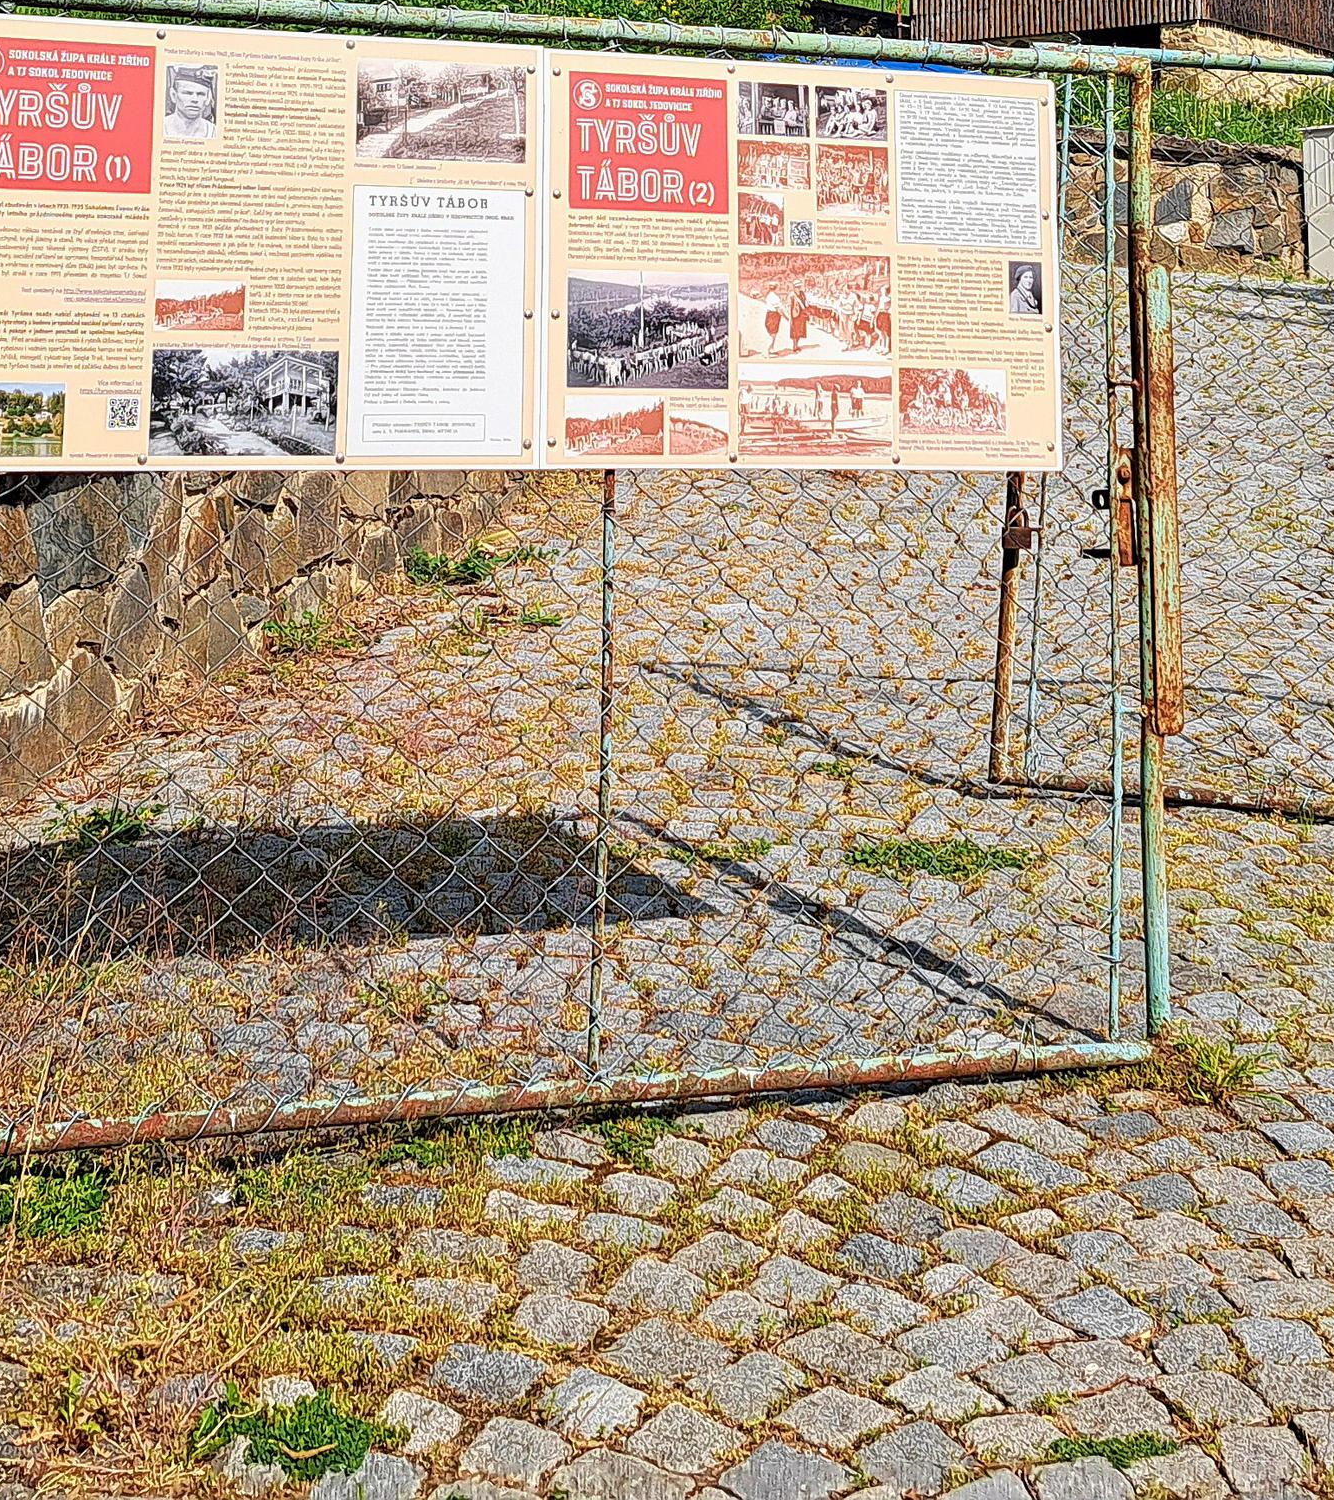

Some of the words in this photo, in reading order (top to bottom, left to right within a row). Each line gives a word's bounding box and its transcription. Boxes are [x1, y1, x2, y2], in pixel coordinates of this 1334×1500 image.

[8, 49, 59, 62] SOKOLSKÁ
[61, 51, 85, 64] ŽUPA
[87, 53, 116, 65] KRÁLE
[118, 54, 150, 67] JIŘÍHO
[8, 68, 14, 76] A
[16, 68, 27, 76] TJ
[28, 68, 59, 78] SOKOL
[60, 70, 113, 81] JEDOVNICE
[605, 83, 647, 95] SOKOLSKÁ
[648, 84, 669, 96] ŽUPA
[670, 86, 694, 97] KRÁLE
[605, 100, 611, 108] A
[612, 100, 621, 108] TJ
[622, 100, 648, 110] SOKOL
[649, 101, 692, 112] JEDOVNICE
[576, 113, 701, 158] TYRŠŮV
[105, 155, 131, 183] (1)
[576, 159, 684, 203] TÁBOR
[688, 181, 715, 206] (2)
